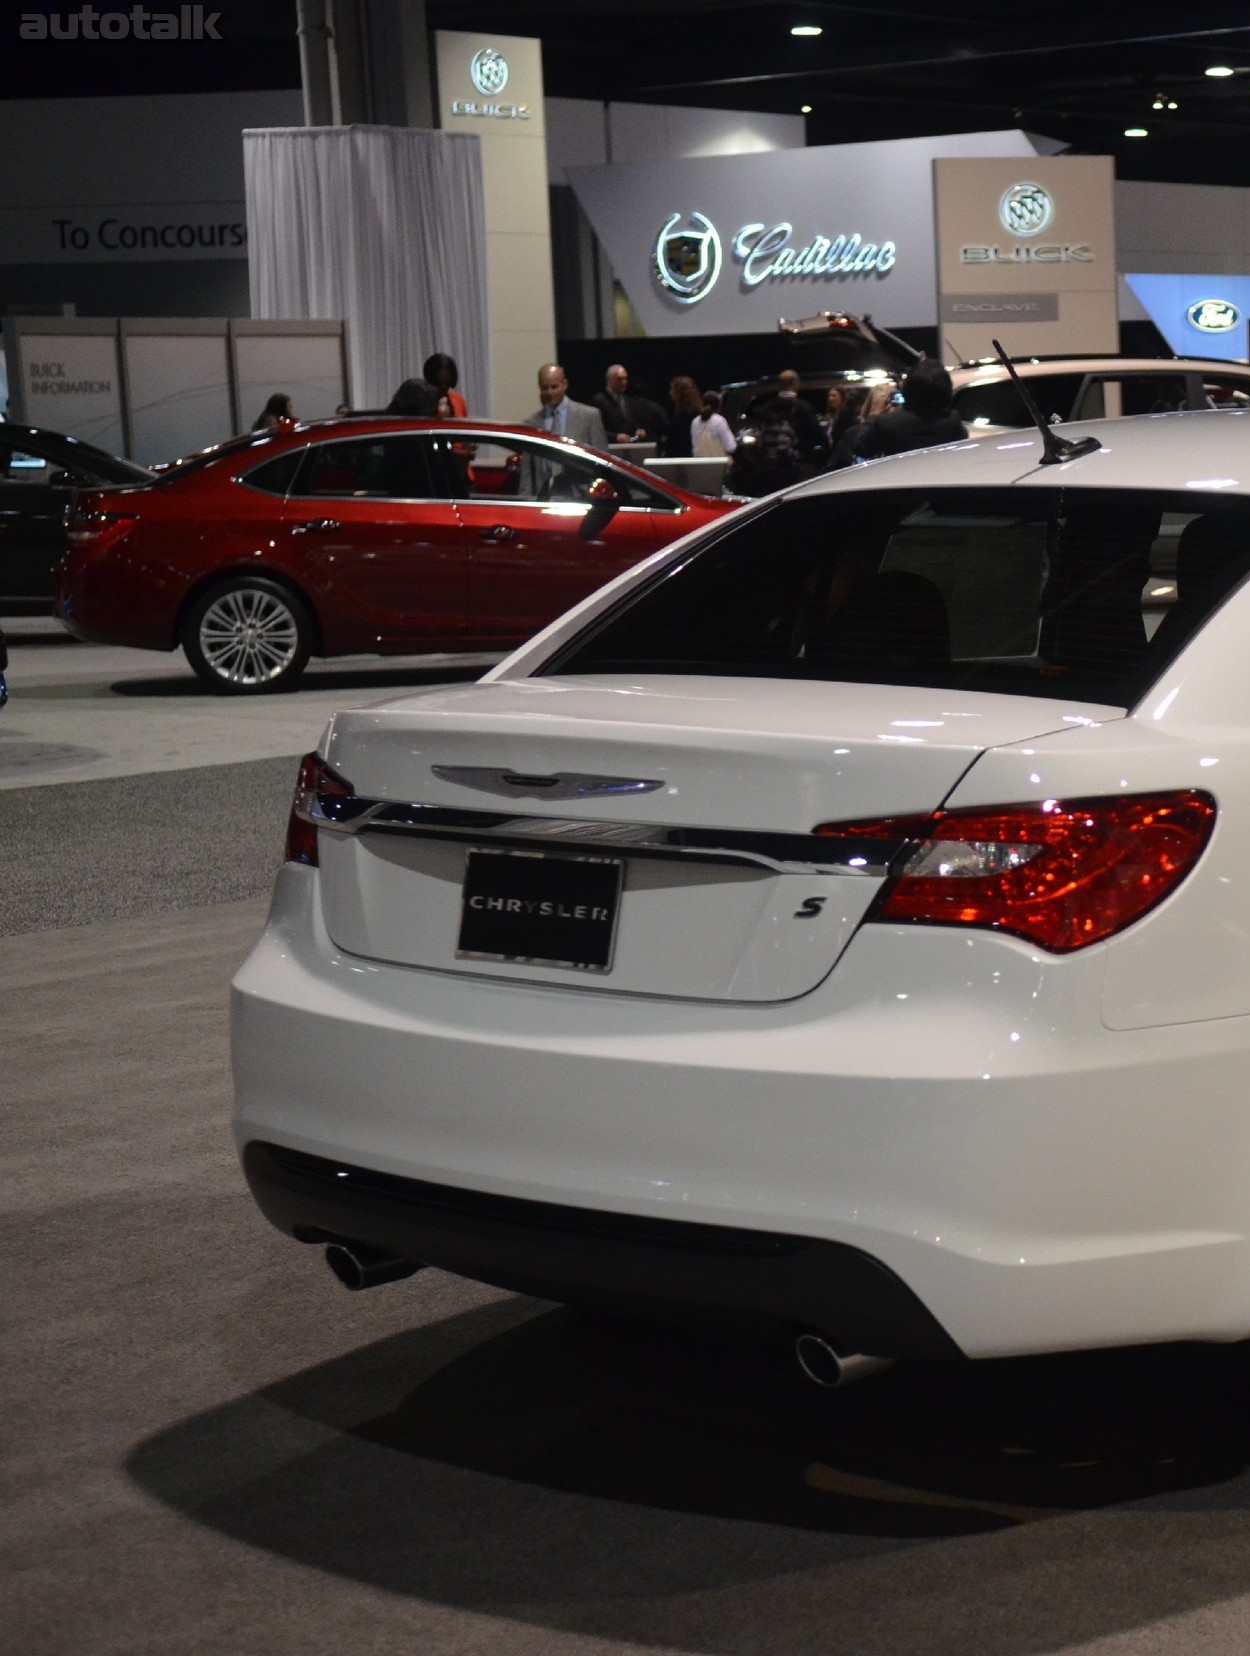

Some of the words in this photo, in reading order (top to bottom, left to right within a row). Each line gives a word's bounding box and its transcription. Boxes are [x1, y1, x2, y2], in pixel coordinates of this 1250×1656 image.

[452, 101, 530, 120] BUICK
[52, 219, 90, 250] To
[98, 218, 247, 249] Concours
[732, 222, 896, 286] Cadillac
[960, 244, 1095, 265] BUICK
[952, 302, 1039, 313] ENCLAVE
[30, 362, 65, 378] BUICK
[32, 380, 112, 395] INFORMATION
[469, 895, 610, 922] CHRYSLER
[793, 896, 828, 920] S
